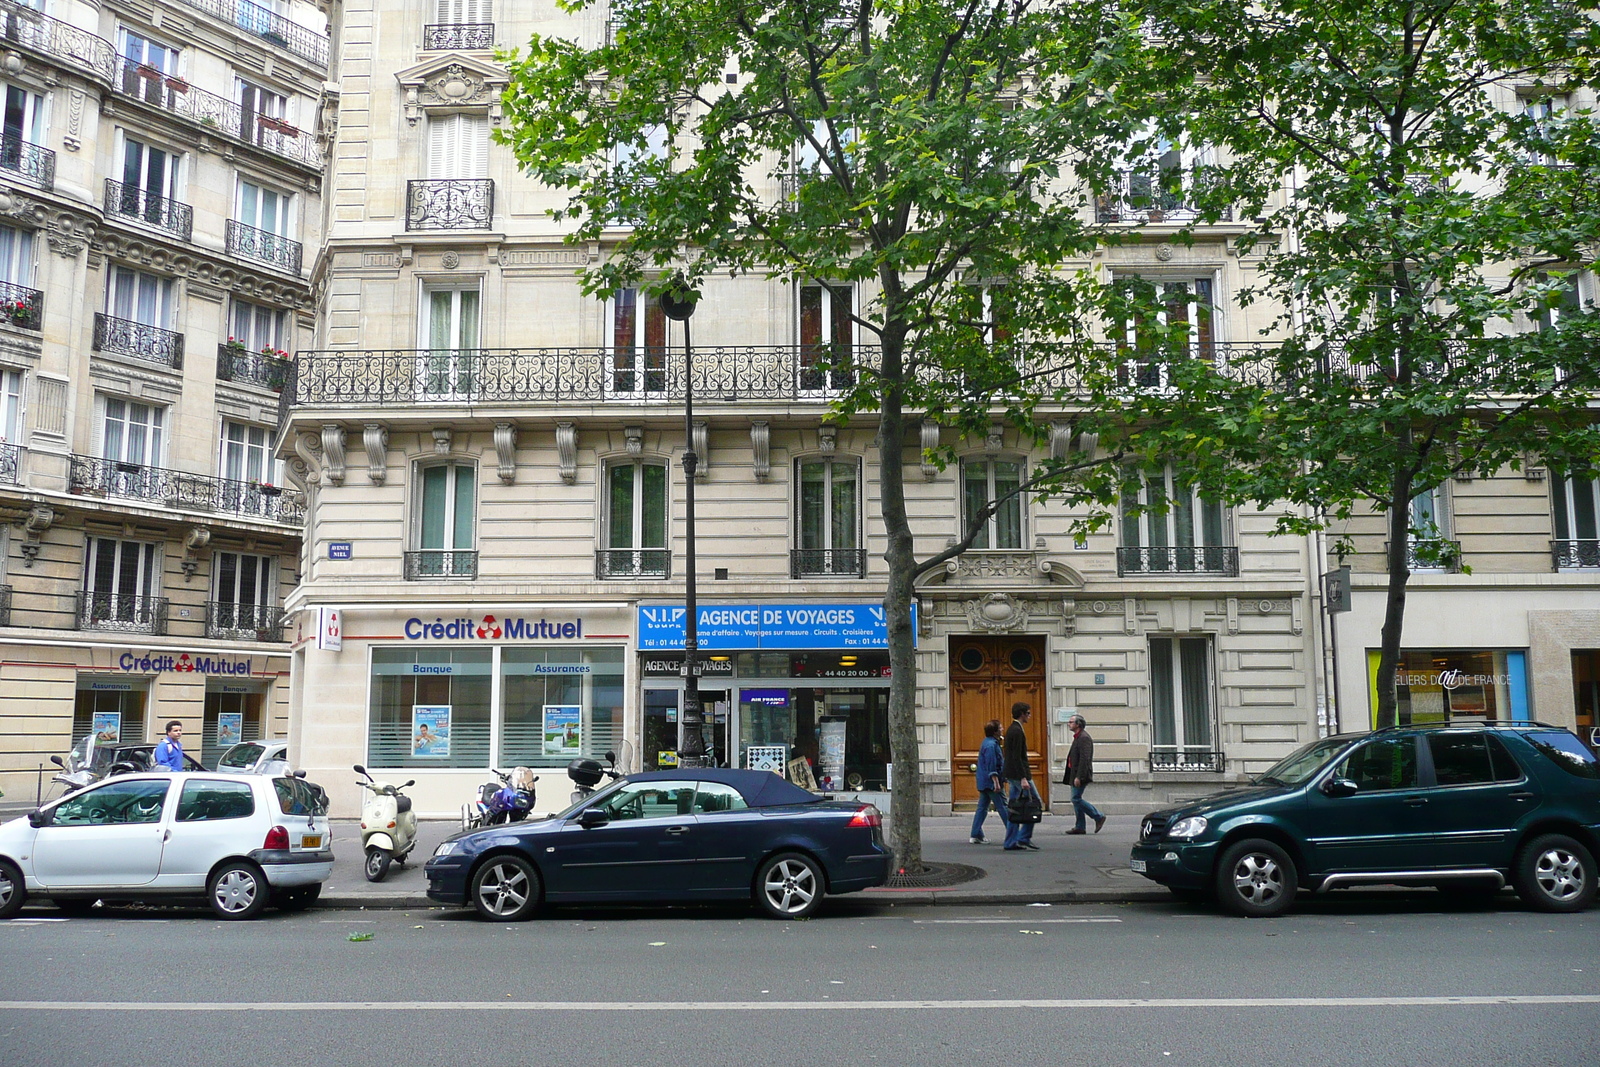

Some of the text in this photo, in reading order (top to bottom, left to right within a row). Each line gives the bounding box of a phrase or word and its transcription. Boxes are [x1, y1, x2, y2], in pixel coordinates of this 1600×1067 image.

[642, 608, 686, 622] V.I.P
[699, 610, 758, 625] AGENCE
[763, 610, 782, 625] DE
[786, 609, 855, 625] VOYAGES
[404, 616, 582, 639] Crédit Mutuel
[119, 652, 251, 674] Crédit Mutuel
[534, 663, 591, 674] Assurances
[644, 660, 680, 671] AGENCE
[412, 664, 453, 674] Banque
[1394, 674, 1427, 686] ELIERS
[1458, 674, 1471, 686] DE
[1474, 674, 1512, 686] FRANCE
[91, 682, 132, 690] Assurances
[223, 685, 248, 693] Banque
